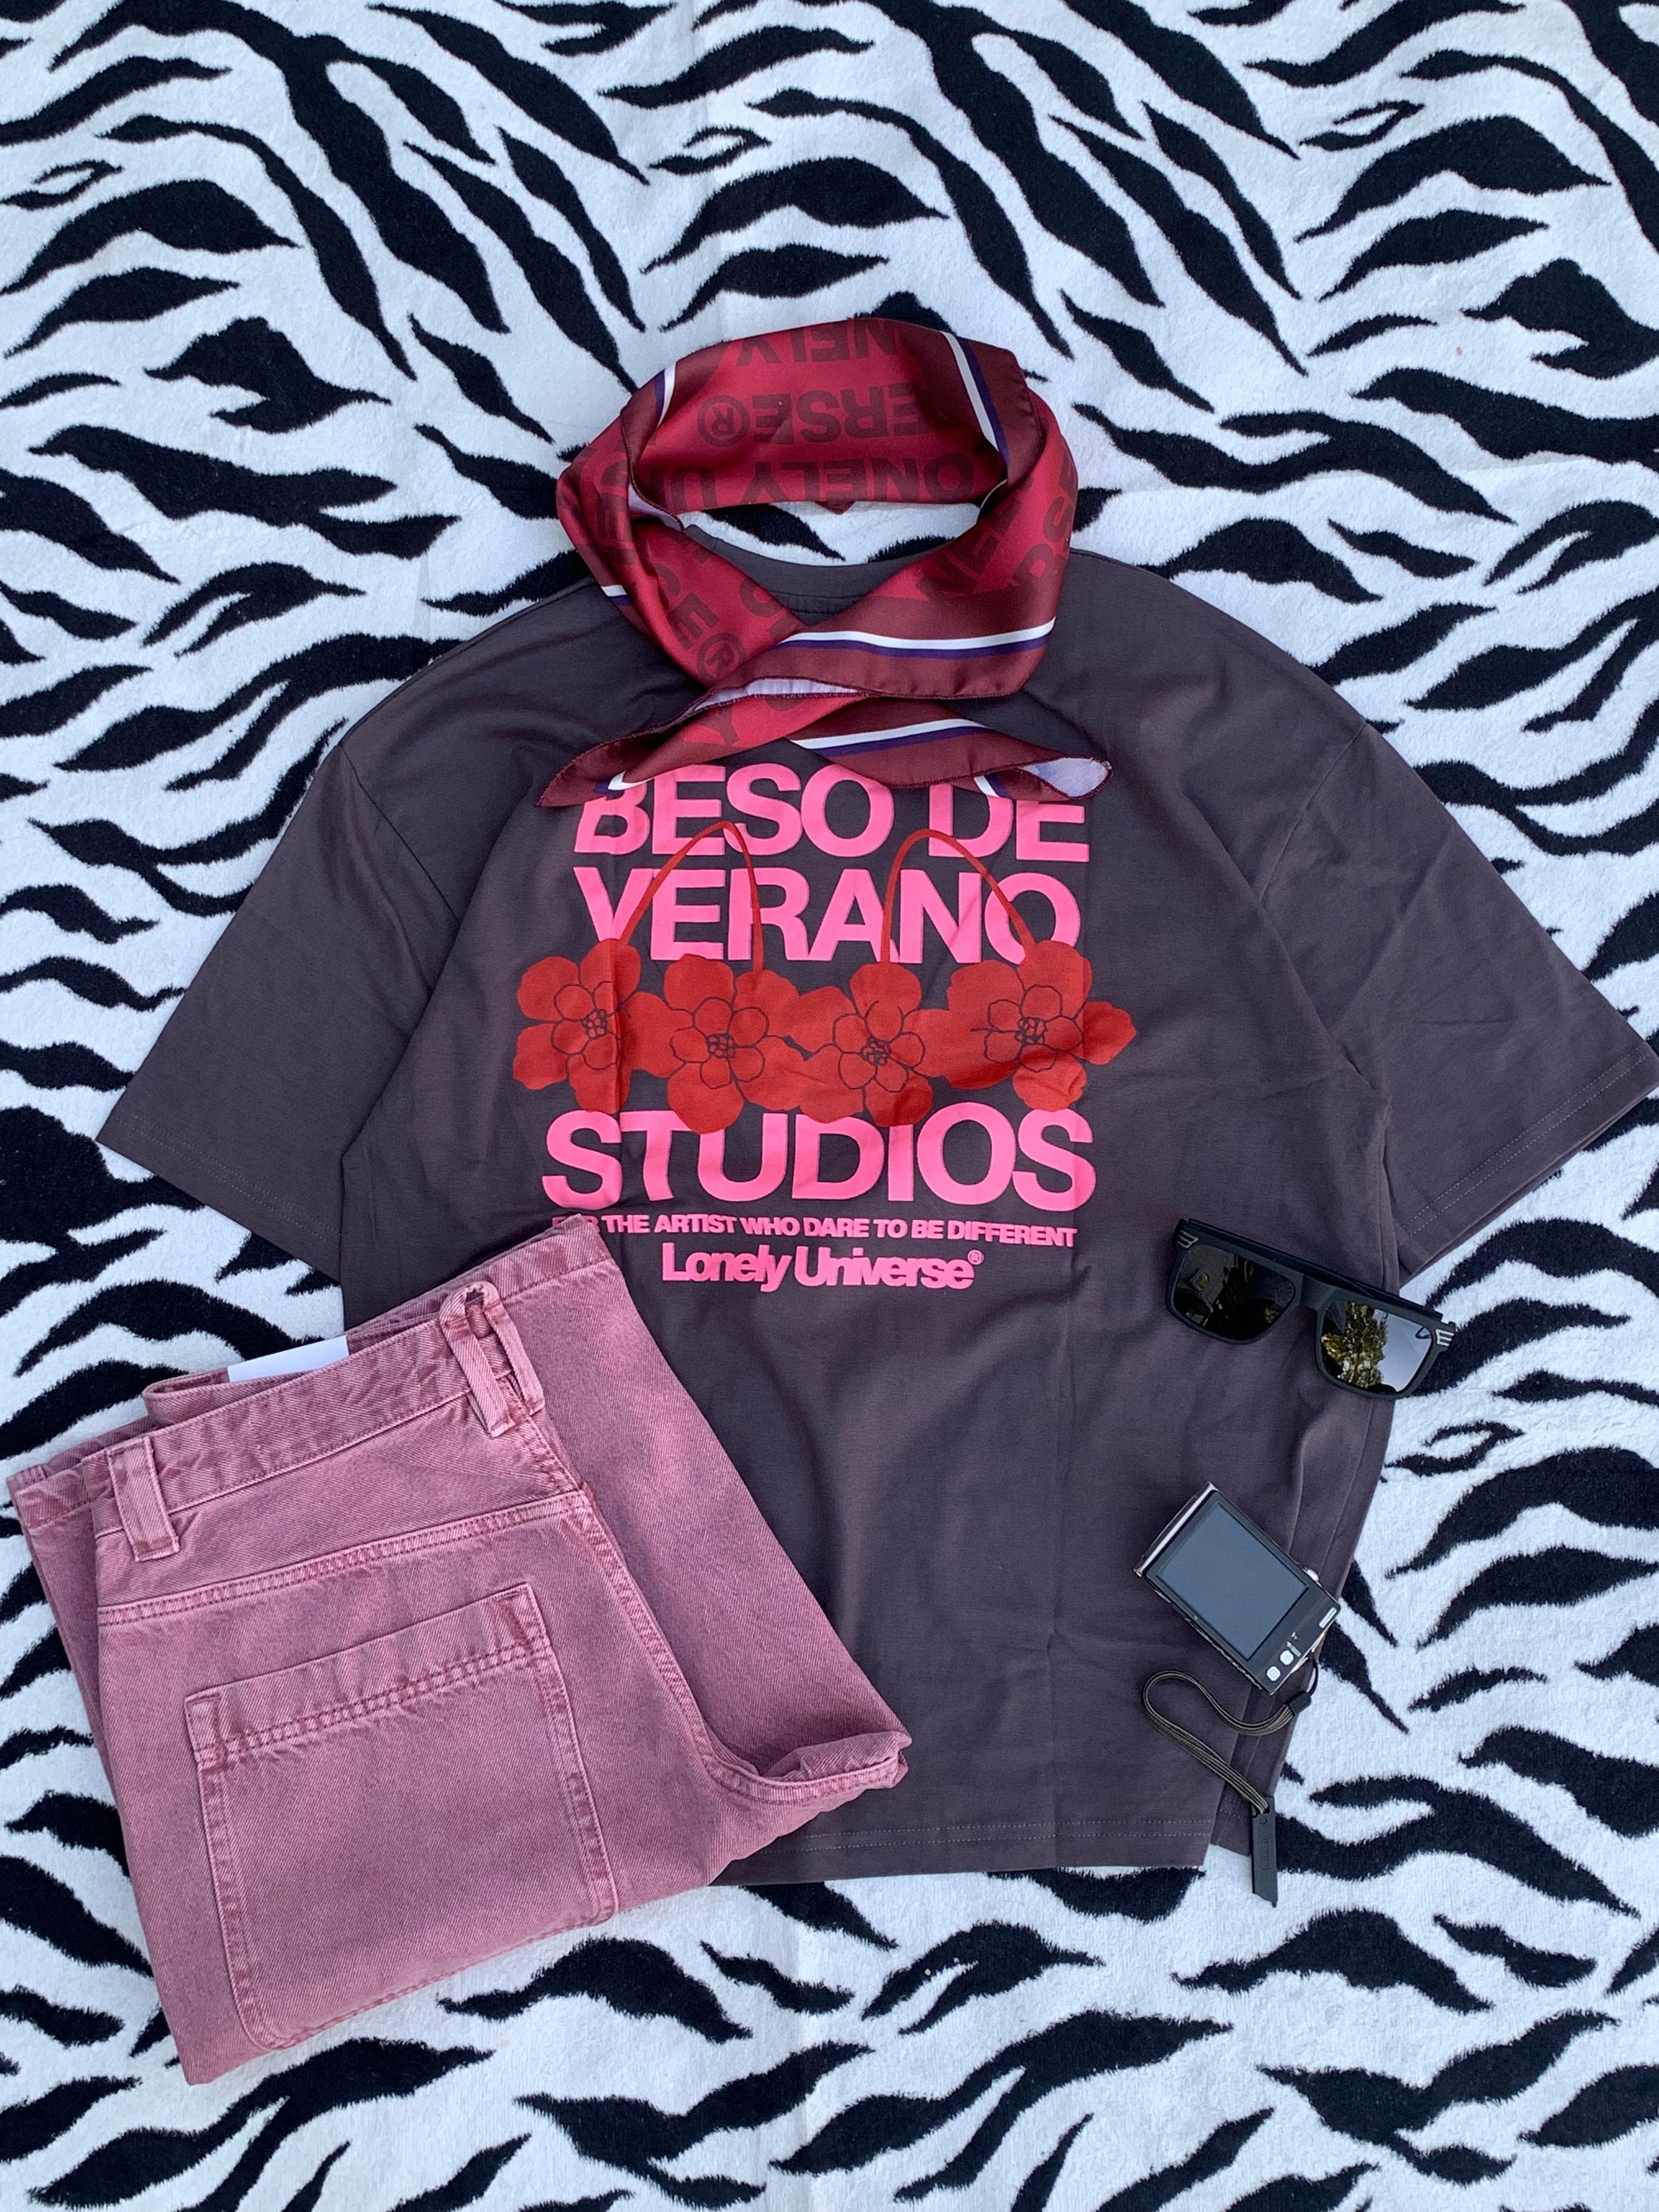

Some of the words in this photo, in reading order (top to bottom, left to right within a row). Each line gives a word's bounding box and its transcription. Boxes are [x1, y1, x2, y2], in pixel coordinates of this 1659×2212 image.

[574, 763, 895, 858] BESO
[928, 784, 1091, 863] DE
[574, 867, 1082, 966] VERANO
[542, 1102, 1097, 1212] STUDIOS
[601, 1214, 650, 1234] THE
[654, 1213, 737, 1234] ARTIST
[740, 1217, 801, 1237] WHO
[803, 1218, 870, 1238] DARE
[873, 1219, 908, 1239] TO
[912, 1220, 945, 1239] BE
[947, 1220, 1078, 1247] DIFFERENT
[662, 1242, 793, 1293] Lonely
